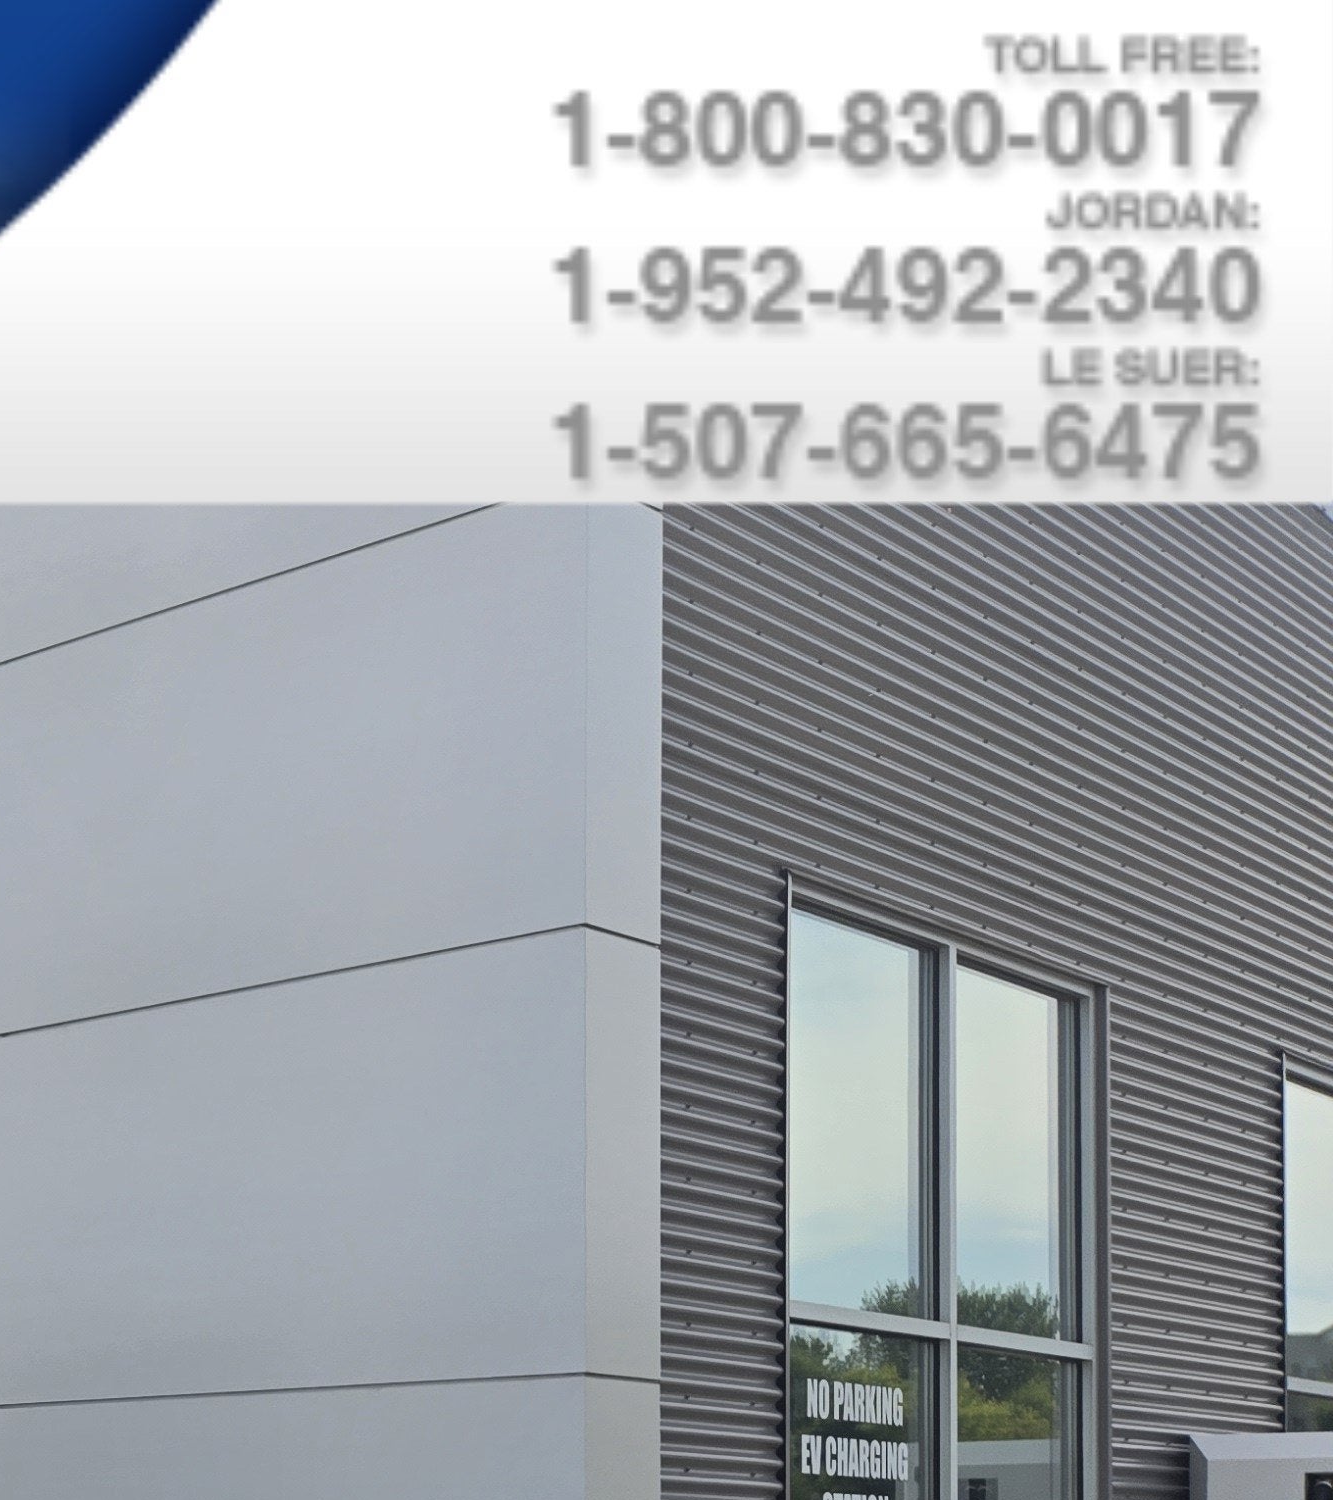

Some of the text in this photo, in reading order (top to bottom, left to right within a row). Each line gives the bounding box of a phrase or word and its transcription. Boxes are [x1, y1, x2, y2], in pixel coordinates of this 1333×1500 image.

[807, 1378, 903, 1427] NO PARKING
[801, 1434, 908, 1480] EV CHARGING
